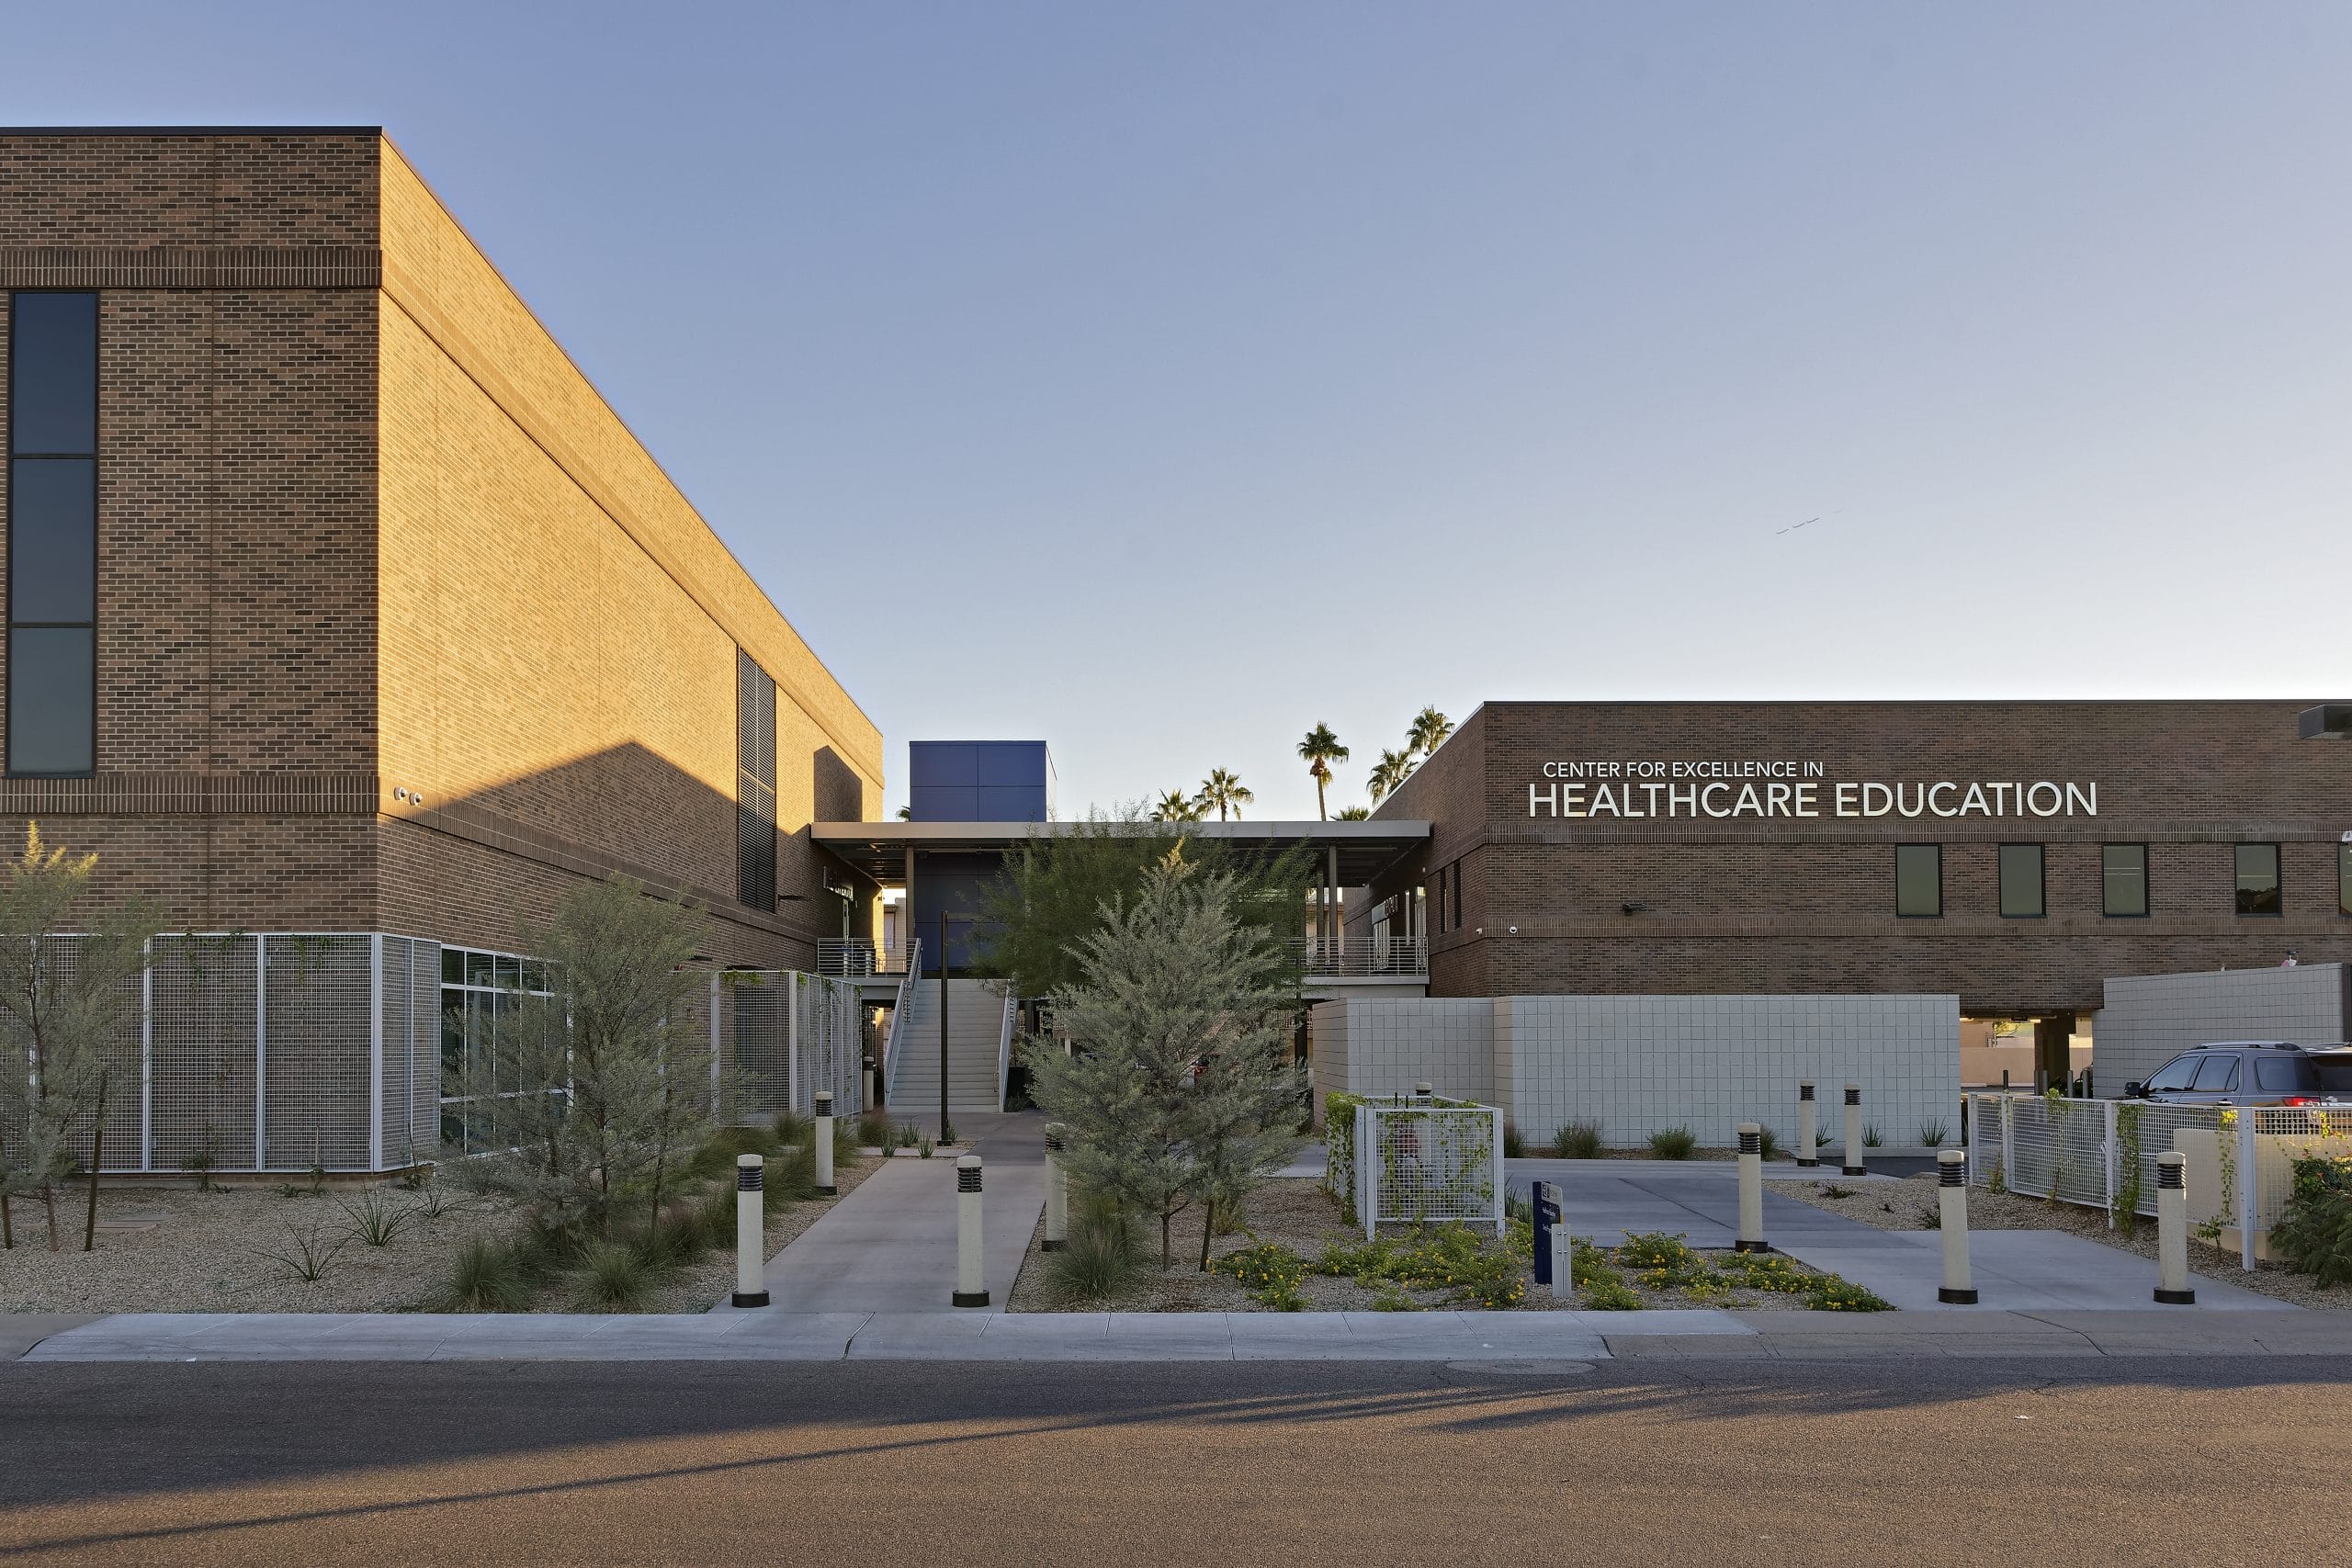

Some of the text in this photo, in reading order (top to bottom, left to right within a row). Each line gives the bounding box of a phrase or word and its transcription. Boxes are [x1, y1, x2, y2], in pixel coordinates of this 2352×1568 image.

[1543, 761, 1824, 778] CENTER FOR EXCELLENCE IN
[1529, 781, 2098, 818] HEALTHCARE EDUCATION
